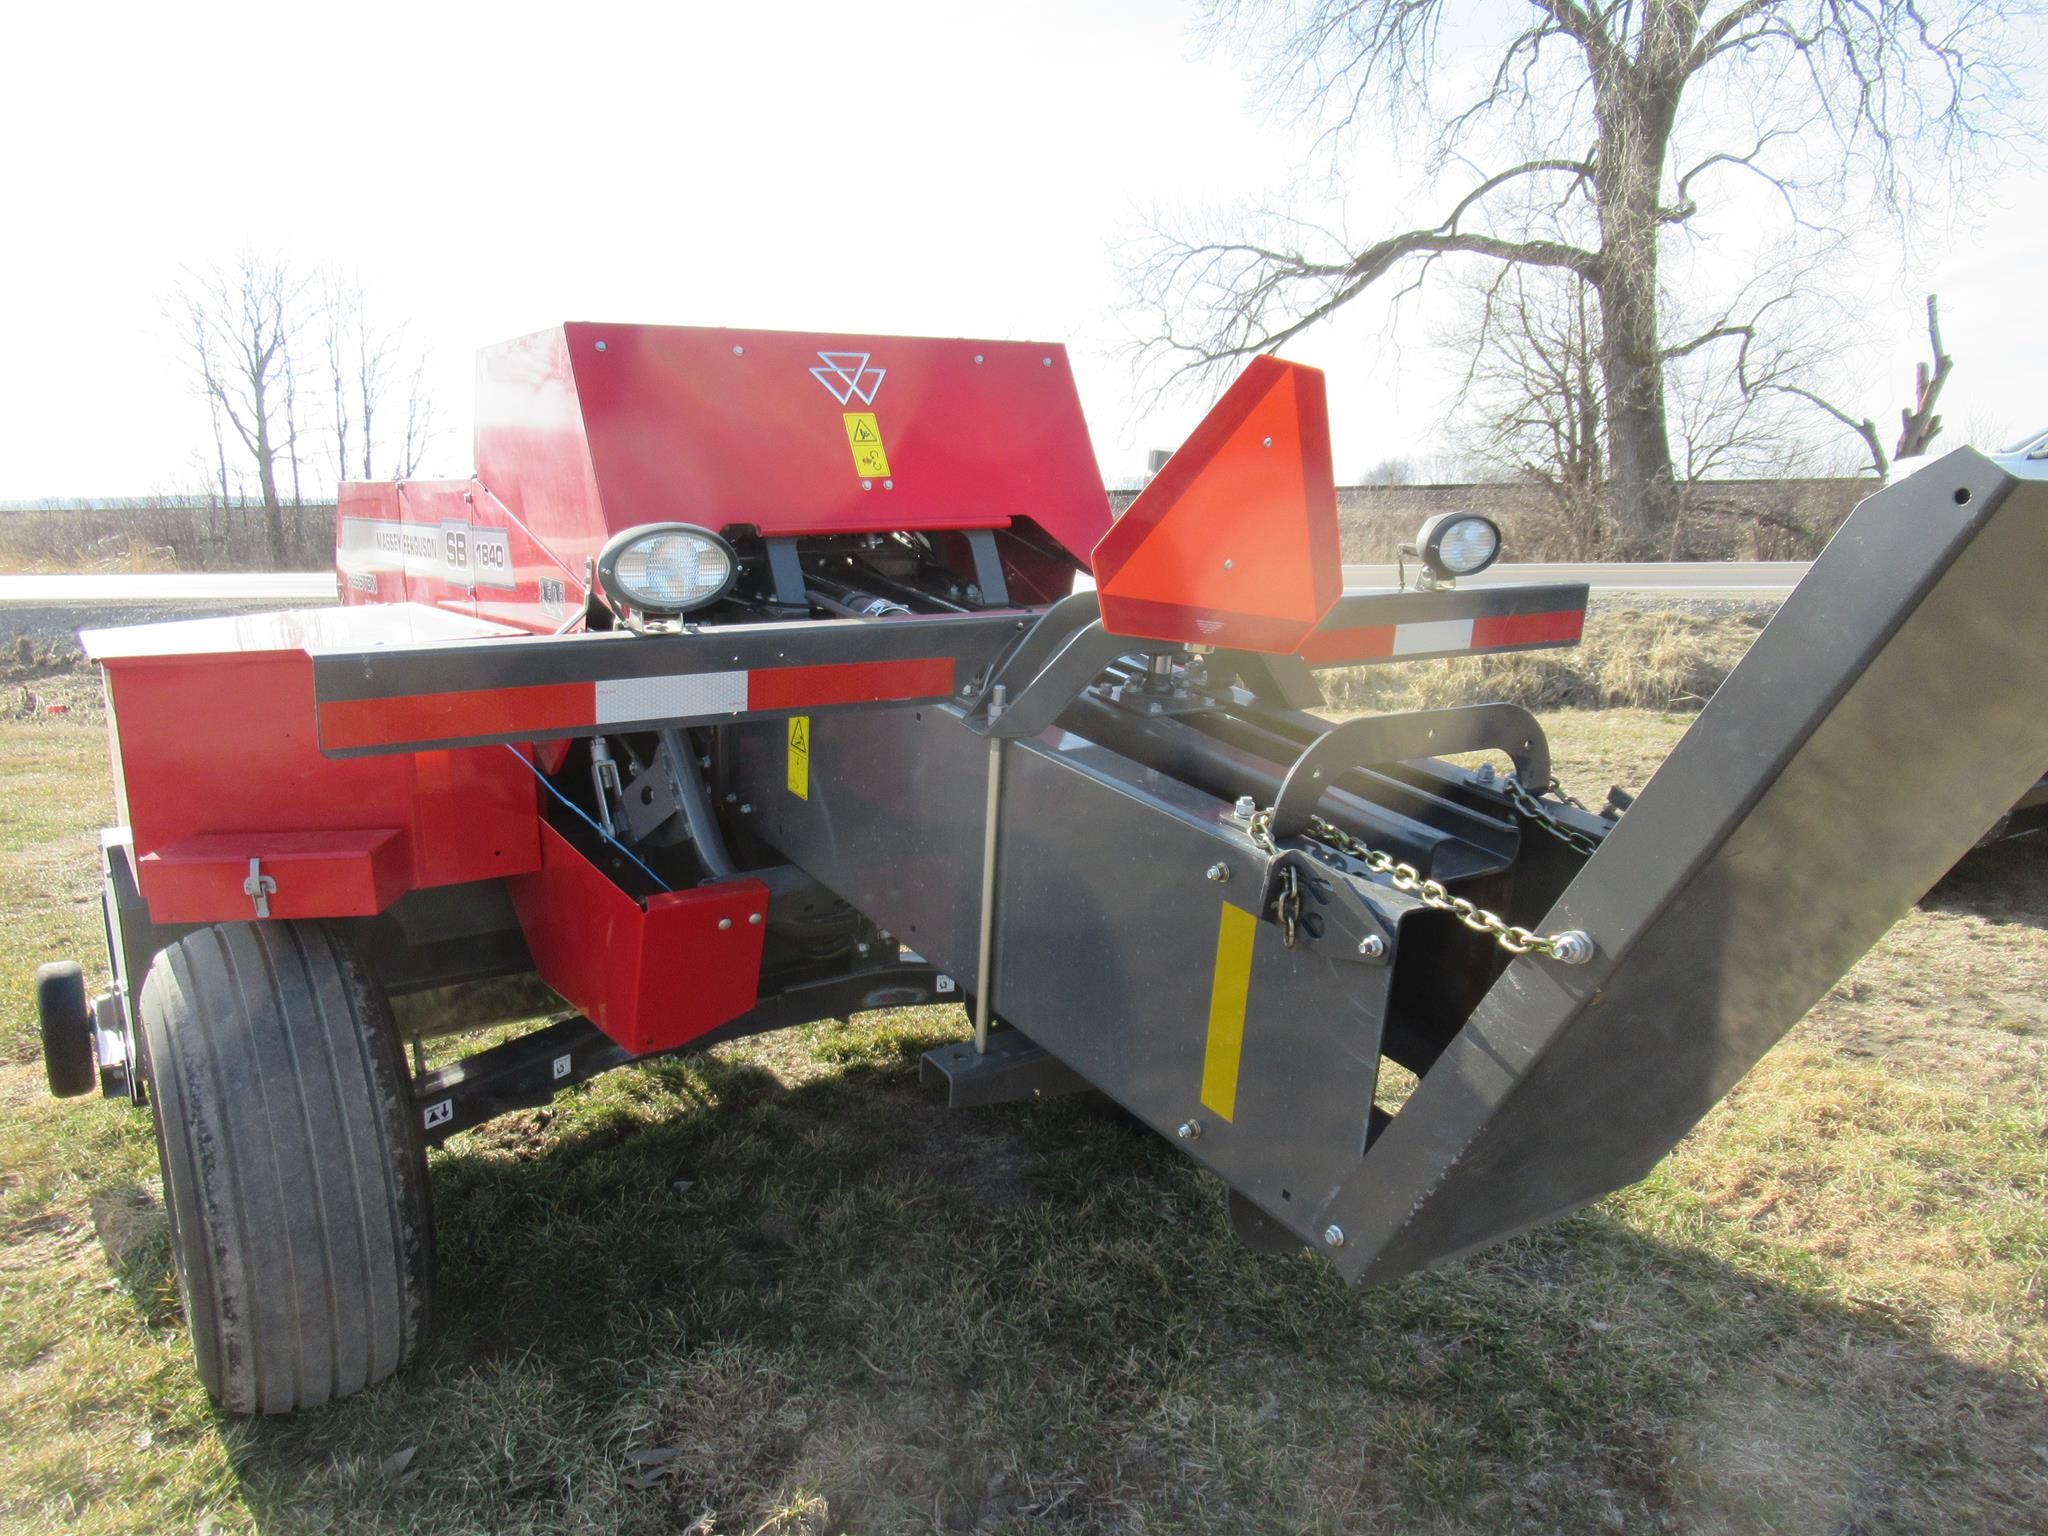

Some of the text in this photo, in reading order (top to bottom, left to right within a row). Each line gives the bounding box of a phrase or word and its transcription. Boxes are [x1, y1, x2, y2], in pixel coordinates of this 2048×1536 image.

[403, 534, 437, 559] FERGUSON
[446, 531, 467, 569] SB
[475, 543, 504, 568] 1840
